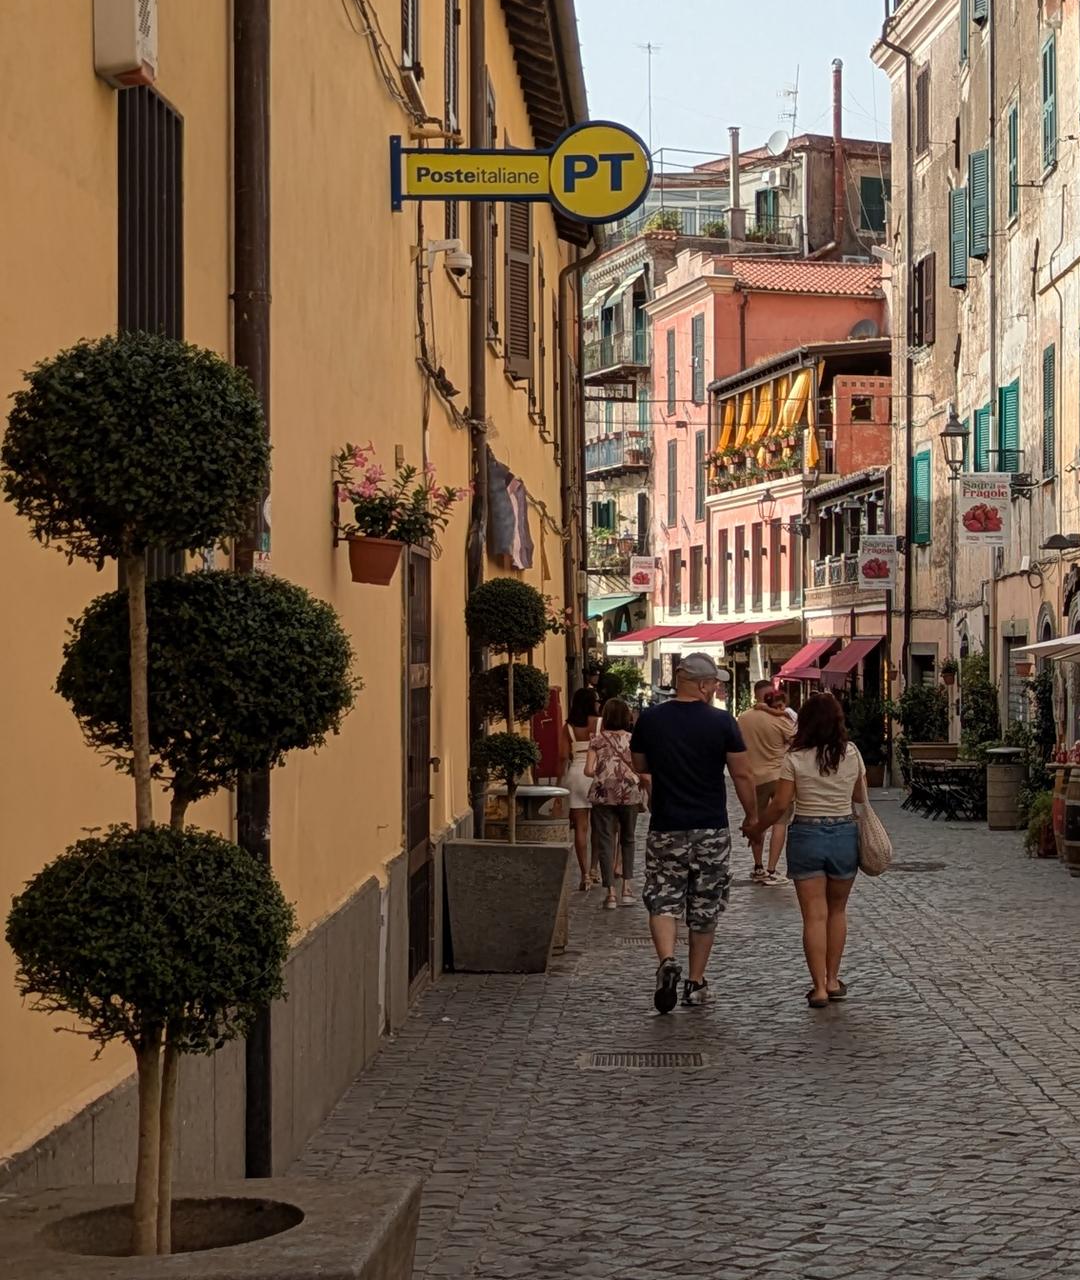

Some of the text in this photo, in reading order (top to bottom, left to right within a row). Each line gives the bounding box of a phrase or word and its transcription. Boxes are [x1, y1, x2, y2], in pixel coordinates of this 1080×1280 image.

[416, 166, 540, 184] Posteitaliane
[563, 153, 635, 193] PT
[962, 487, 1008, 498] Fragole
